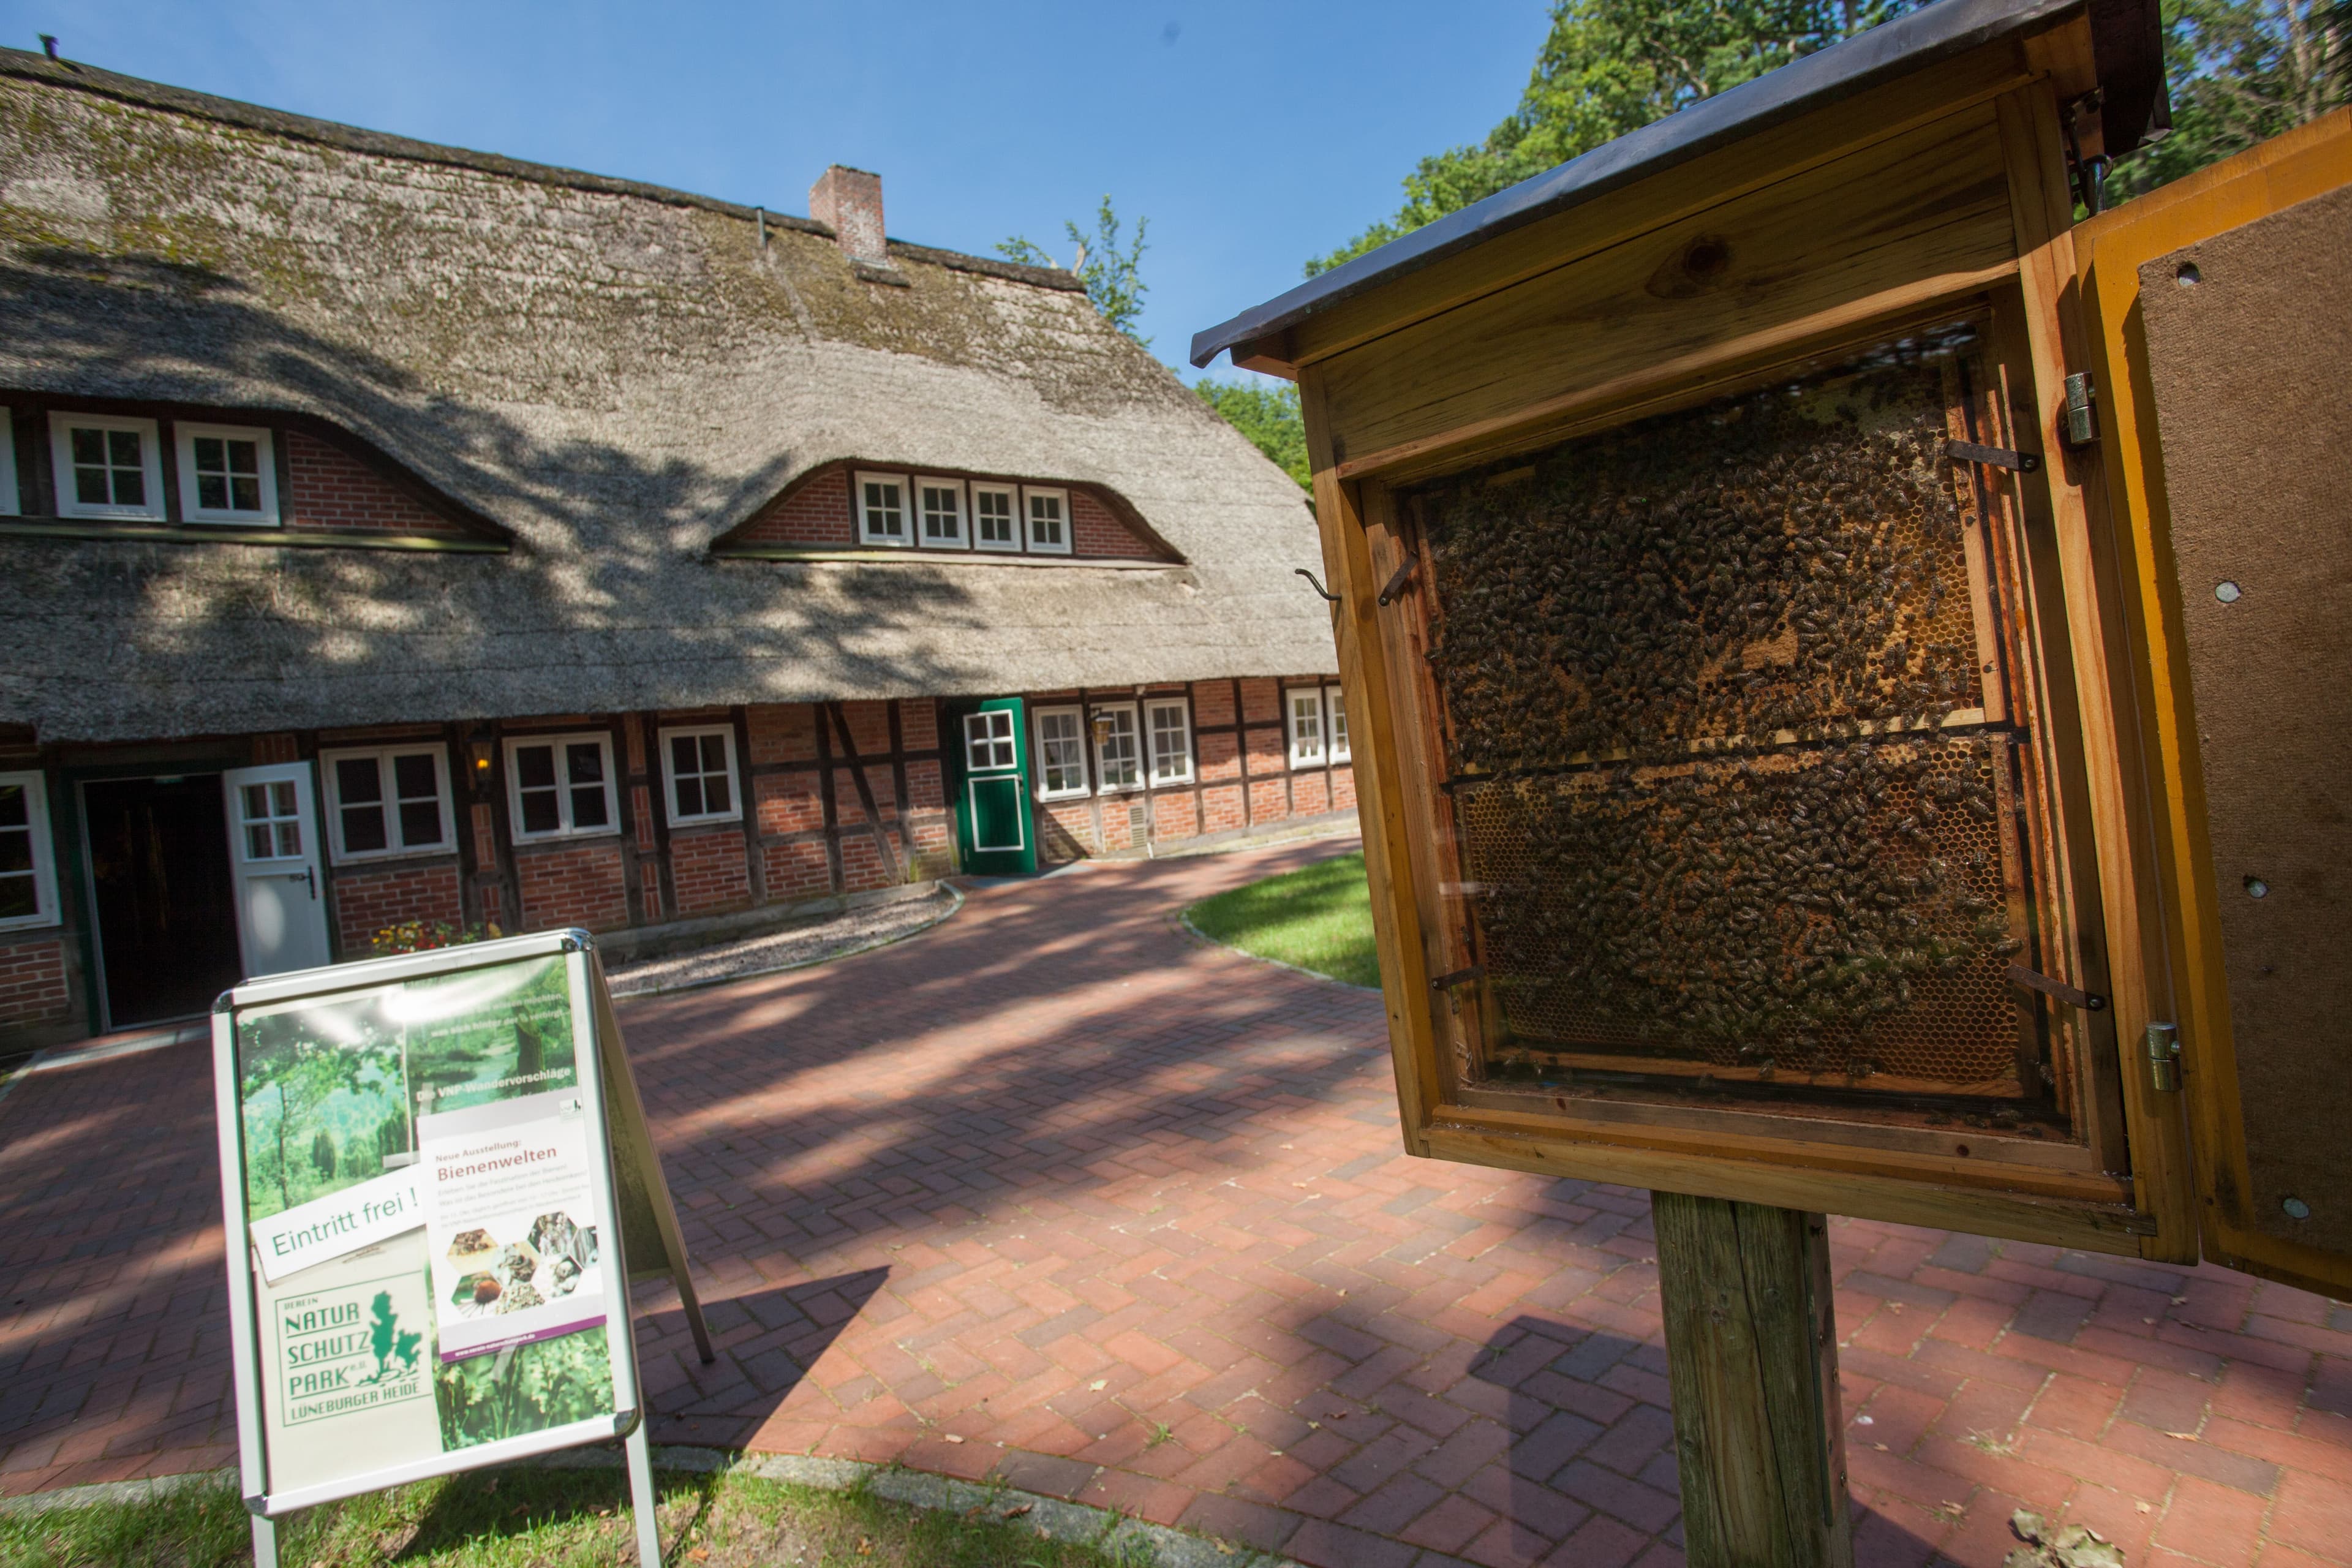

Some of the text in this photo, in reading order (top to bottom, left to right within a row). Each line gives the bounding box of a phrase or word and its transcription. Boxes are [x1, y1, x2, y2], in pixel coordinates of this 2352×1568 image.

[473, 1019, 502, 1030] hinter
[437, 1066, 571, 1098] VNP-Wandervorschläge
[435, 1140, 522, 1163] Neue Ausstellung:
[438, 1148, 557, 1181] Bienenwelten
[272, 1211, 358, 1256] Eintritt
[362, 1192, 403, 1224] frei
[410, 1187, 418, 1207] !
[284, 1297, 318, 1310] VEREIN
[285, 1302, 360, 1334] NATUR
[288, 1331, 371, 1365] SCHUTZ
[289, 1365, 350, 1396] PARK
[291, 1382, 420, 1420] LÜNEBURGER HEIDE
